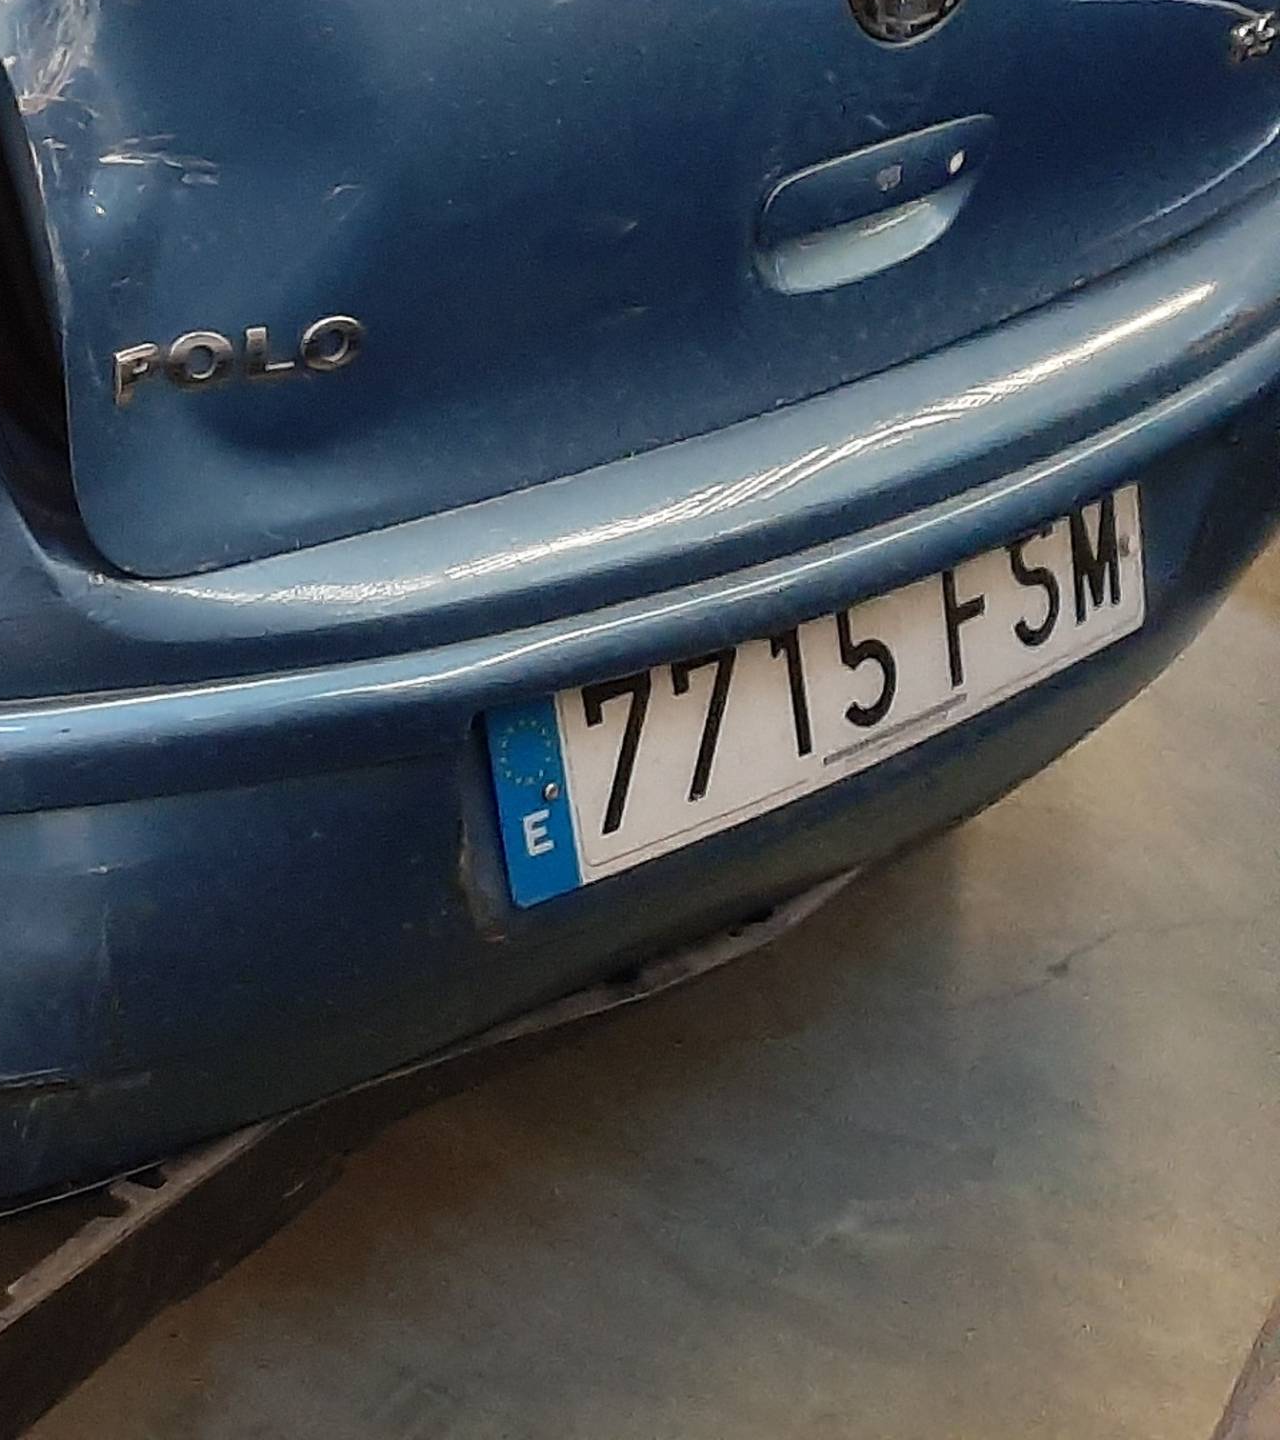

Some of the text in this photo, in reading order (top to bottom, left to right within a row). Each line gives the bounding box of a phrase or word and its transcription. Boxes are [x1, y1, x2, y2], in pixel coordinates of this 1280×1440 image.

[113, 314, 365, 404] POLO
[522, 497, 1120, 858] E 7715 FSM
